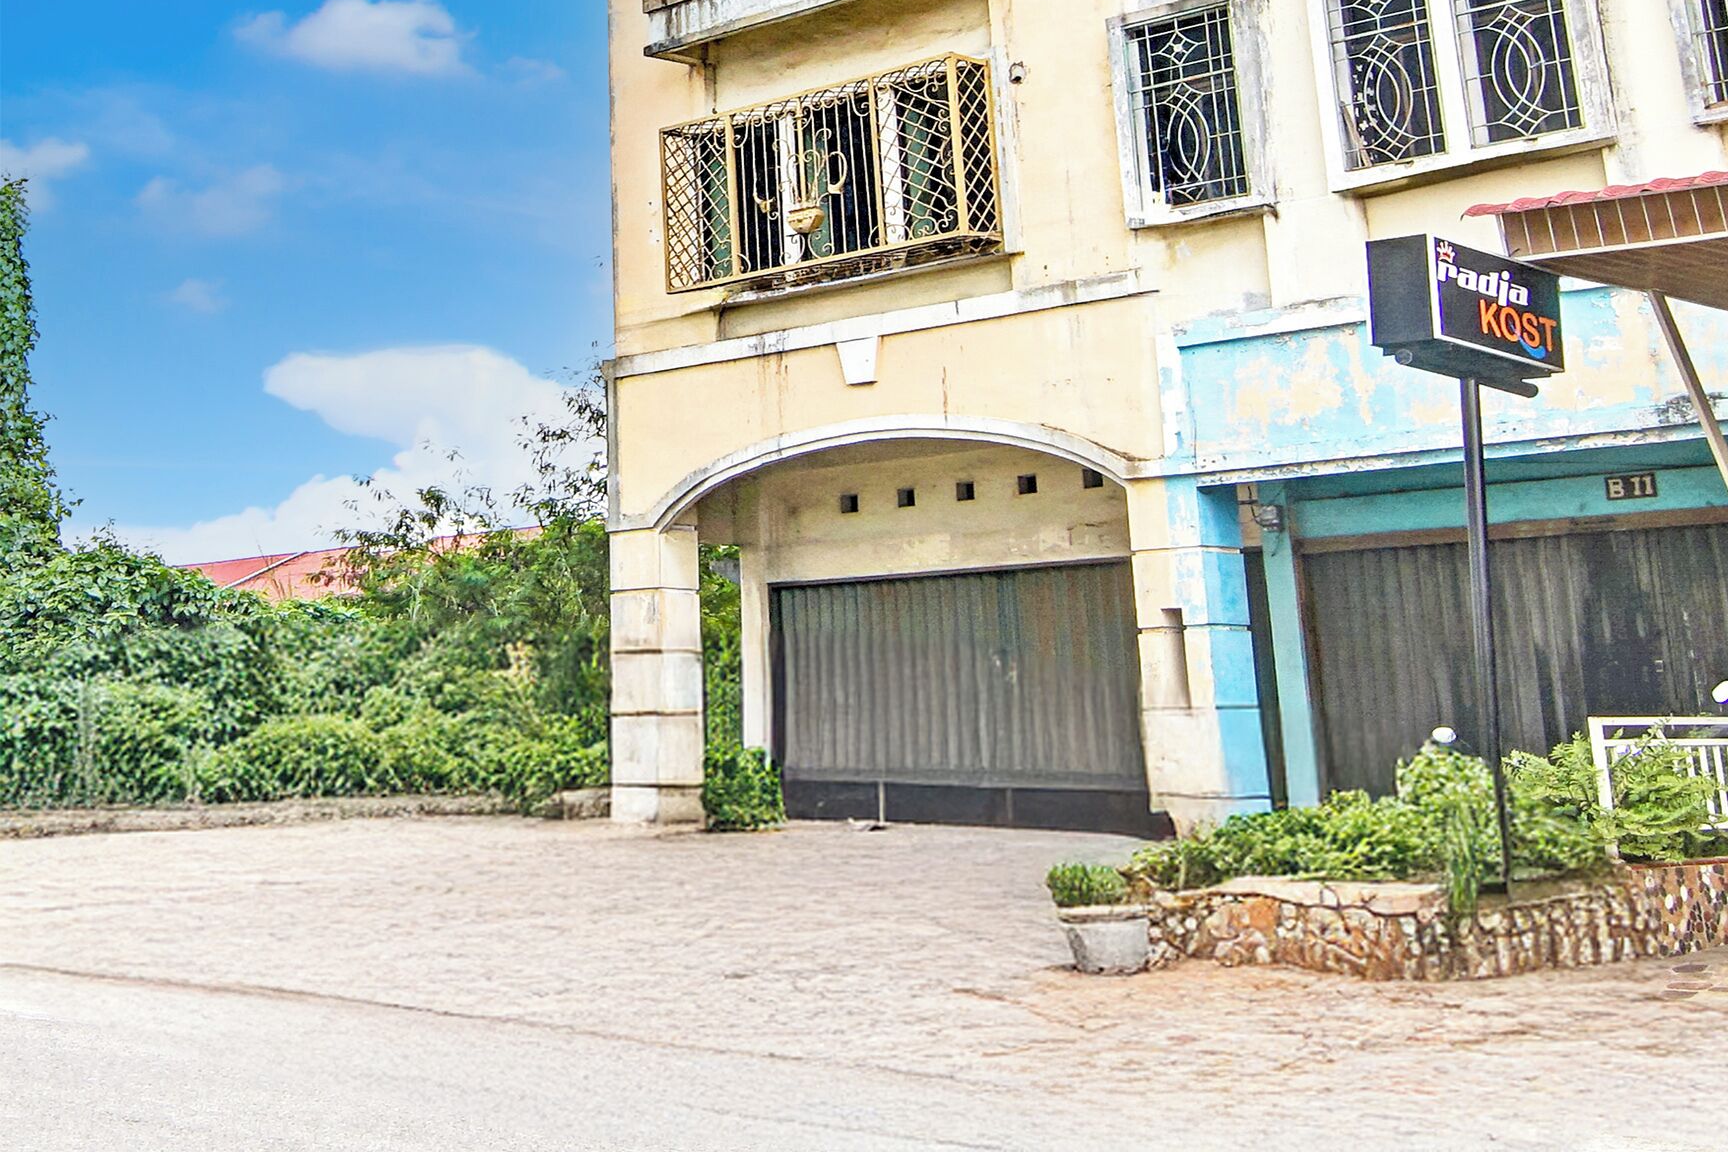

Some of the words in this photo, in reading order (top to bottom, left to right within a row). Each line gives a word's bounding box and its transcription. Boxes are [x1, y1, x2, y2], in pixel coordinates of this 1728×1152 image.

[1437, 260, 1529, 307] radja
[1479, 298, 1557, 352] KOST
[1607, 478, 1625, 499] B
[1629, 475, 1654, 496] 11
